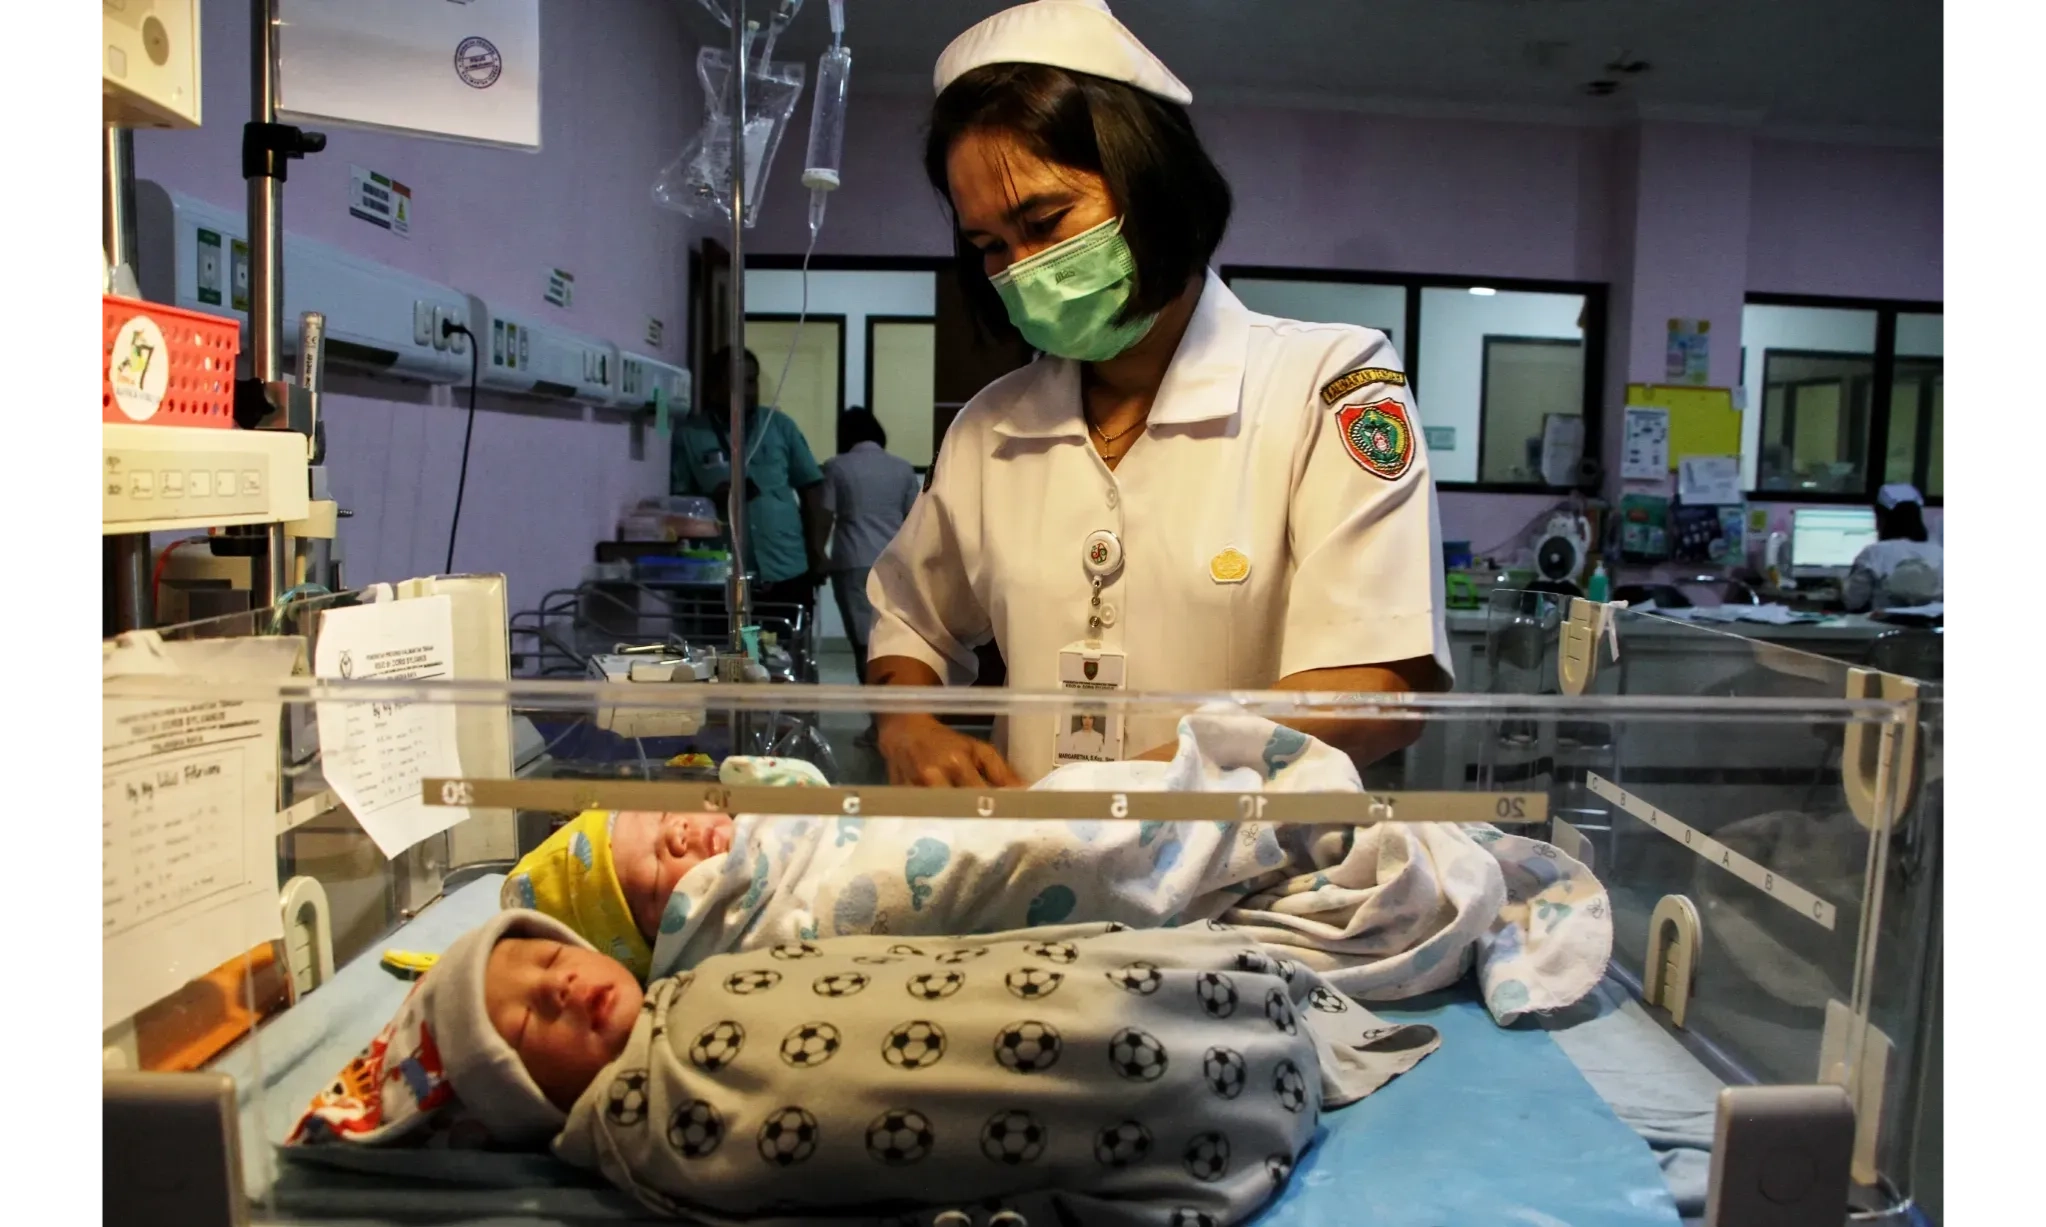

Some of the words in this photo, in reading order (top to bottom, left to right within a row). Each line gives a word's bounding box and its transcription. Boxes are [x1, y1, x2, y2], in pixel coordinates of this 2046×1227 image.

[1651, 810, 1658, 825] A
[1722, 850, 1730, 868] A
[1765, 873, 1773, 891] B
[1813, 900, 1822, 919] C
